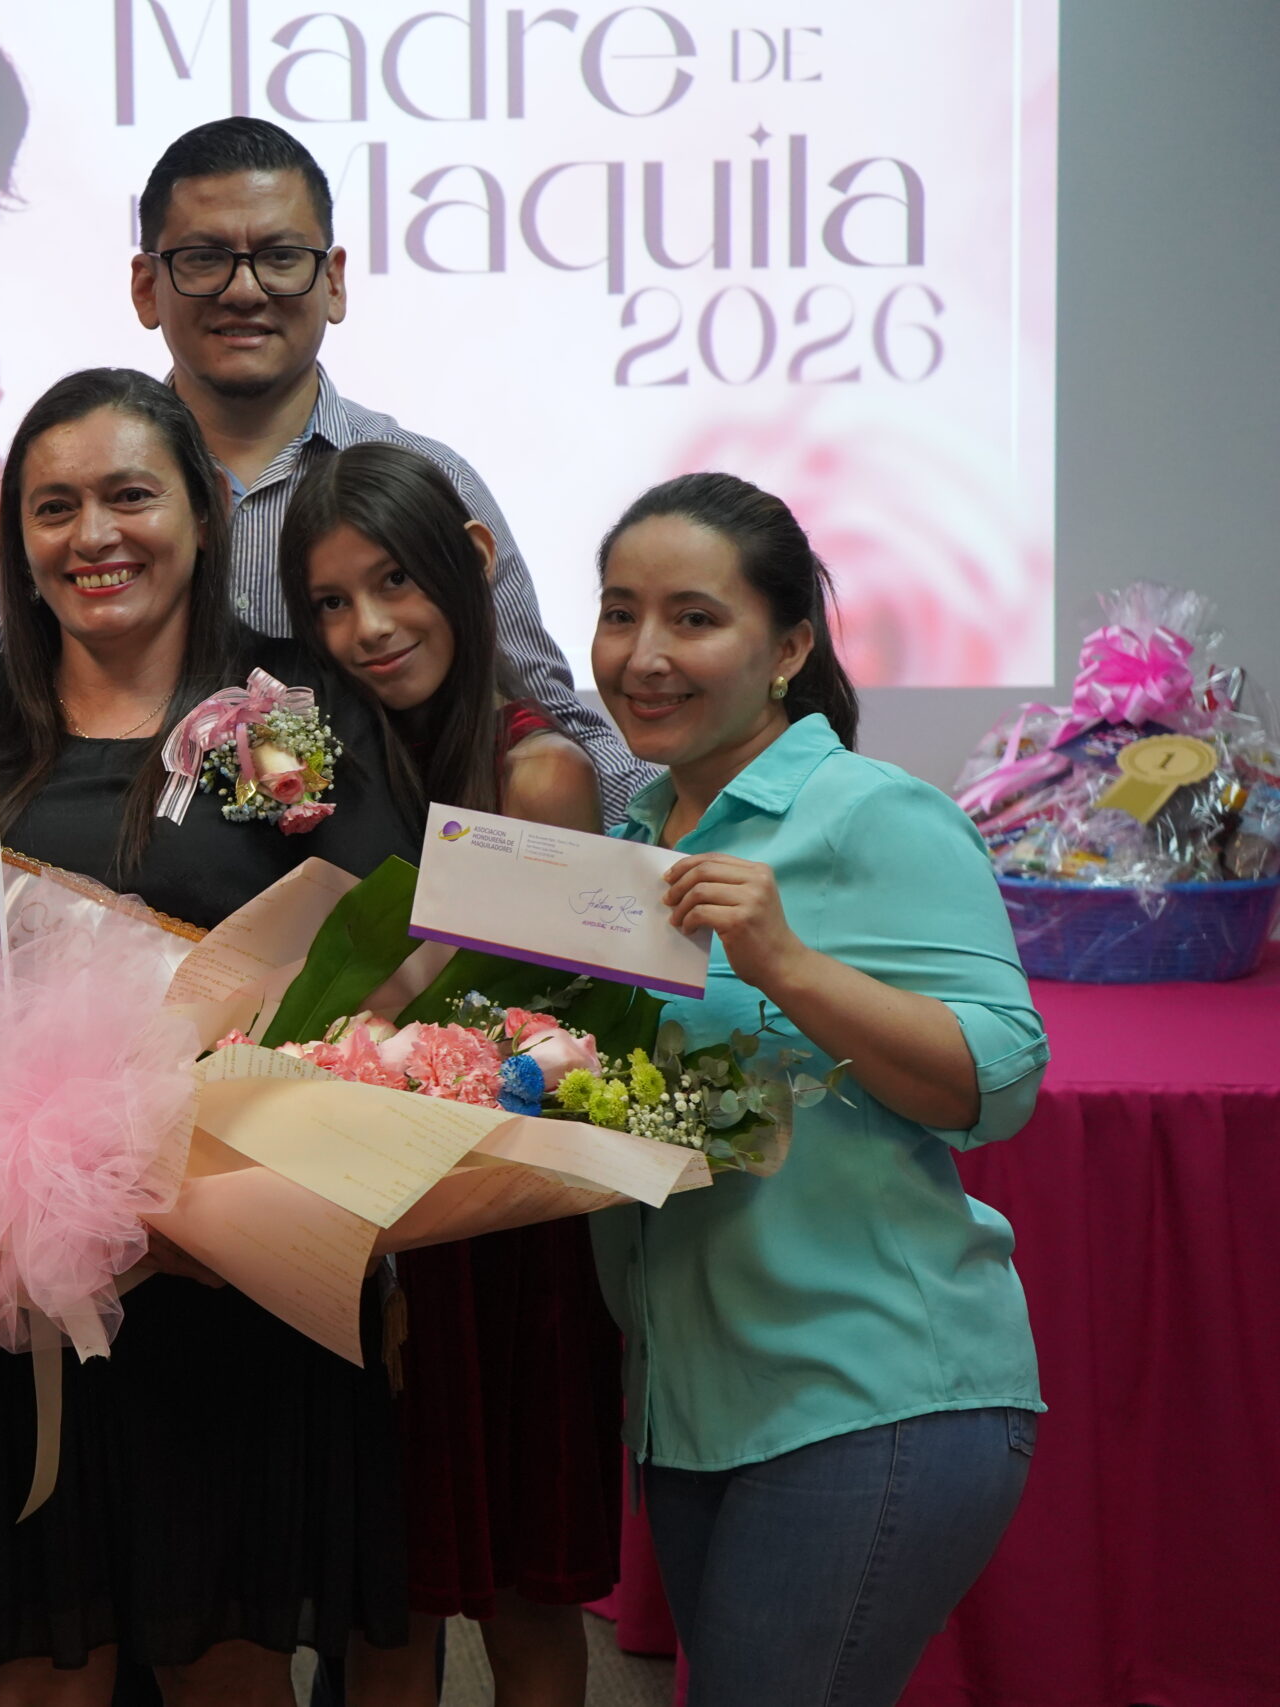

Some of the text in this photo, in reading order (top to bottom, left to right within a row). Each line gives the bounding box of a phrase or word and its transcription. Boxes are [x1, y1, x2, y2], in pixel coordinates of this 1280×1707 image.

[114, 0, 823, 126] Madre DE
[614, 283, 945, 386] 2026
[471, 840, 513, 853] MAQUILADORES
